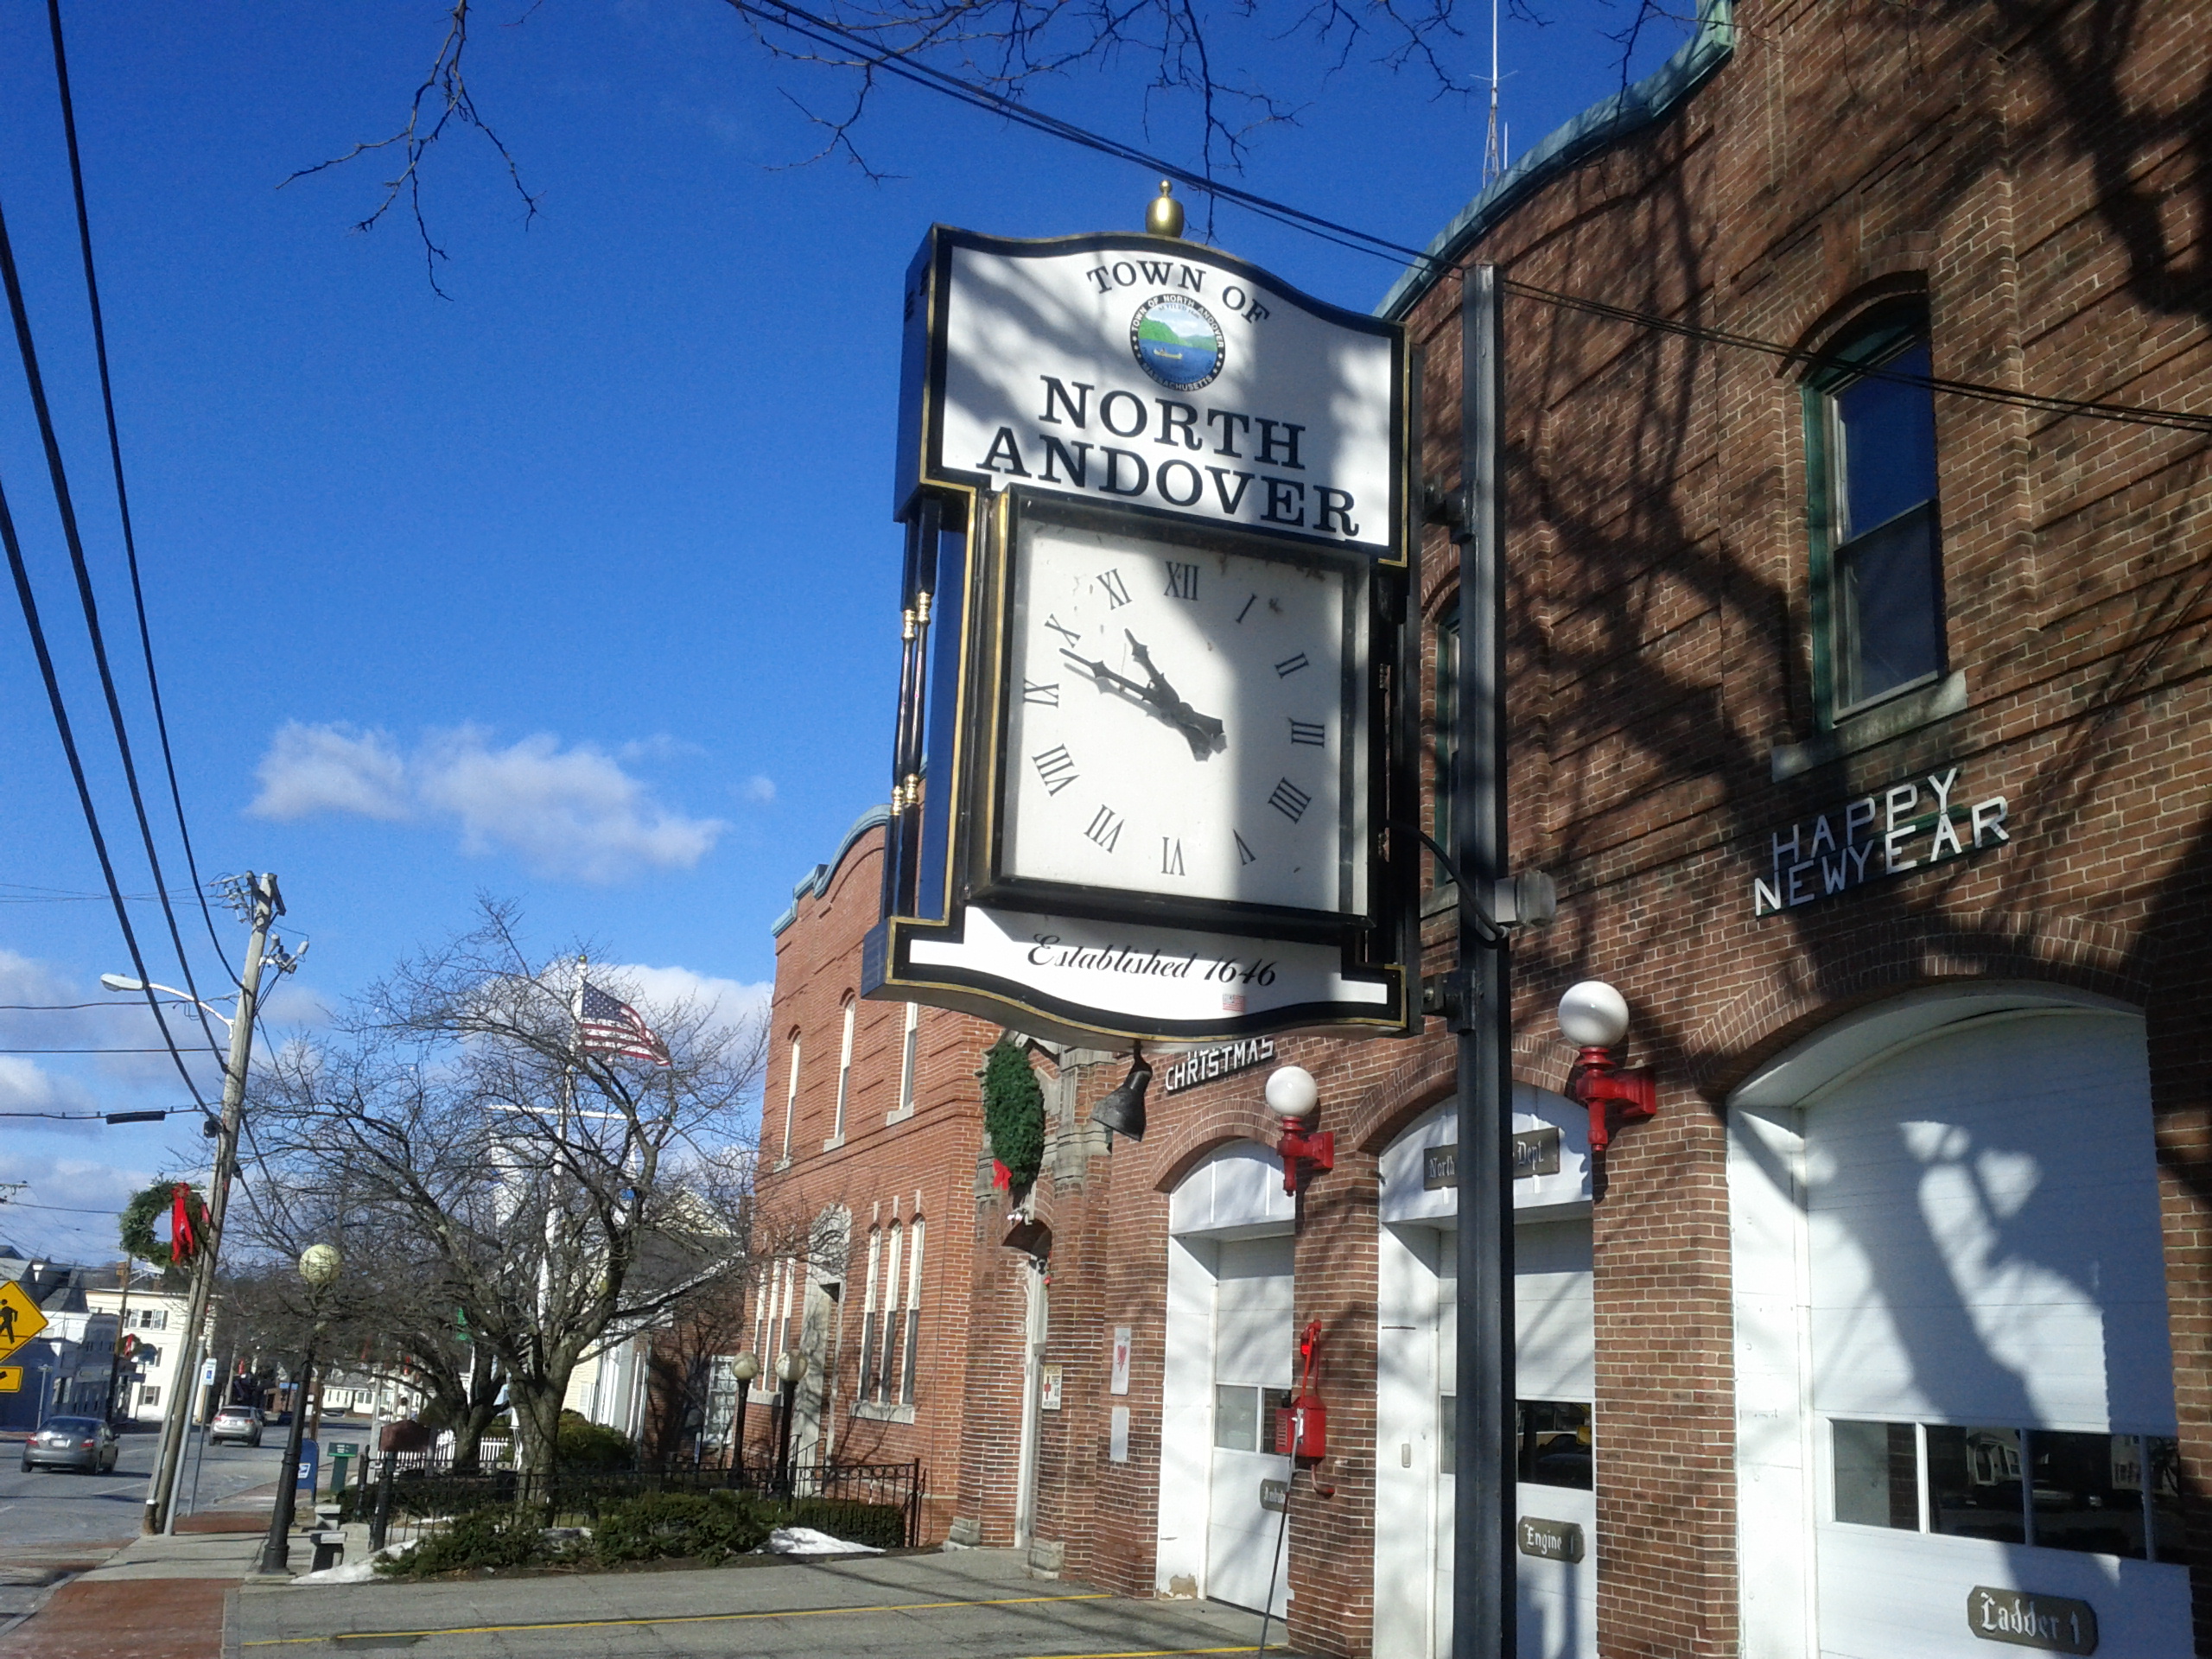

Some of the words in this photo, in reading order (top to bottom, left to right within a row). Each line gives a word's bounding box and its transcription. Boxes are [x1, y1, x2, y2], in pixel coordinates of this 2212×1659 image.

[1086, 259, 1206, 294] TOWN
[1222, 285, 1270, 324] OF
[1131, 307, 1147, 332] TOWN
[1147, 296, 1159, 308] OF
[1163, 295, 1195, 307] NORTH
[1197, 307, 1224, 347] ANDOVER
[1141, 363, 1213, 391] MASSACHUSETTS
[1039, 375, 1306, 470] NORTH
[977, 426, 1360, 537] ANDOVER
[1096, 568, 1133, 610] XI
[1164, 561, 1200, 601] XII
[1045, 613, 1081, 648] X
[1772, 767, 1957, 871] HAPPY
[1027, 933, 1198, 978] Established
[1204, 955, 1278, 987] 1646
[1165, 1038, 1274, 1090] CHRISTMAS
[1429, 1155, 1455, 1178] North
[1524, 1523, 1562, 1554] Engine
[1980, 1592, 2060, 1638] Ladder
